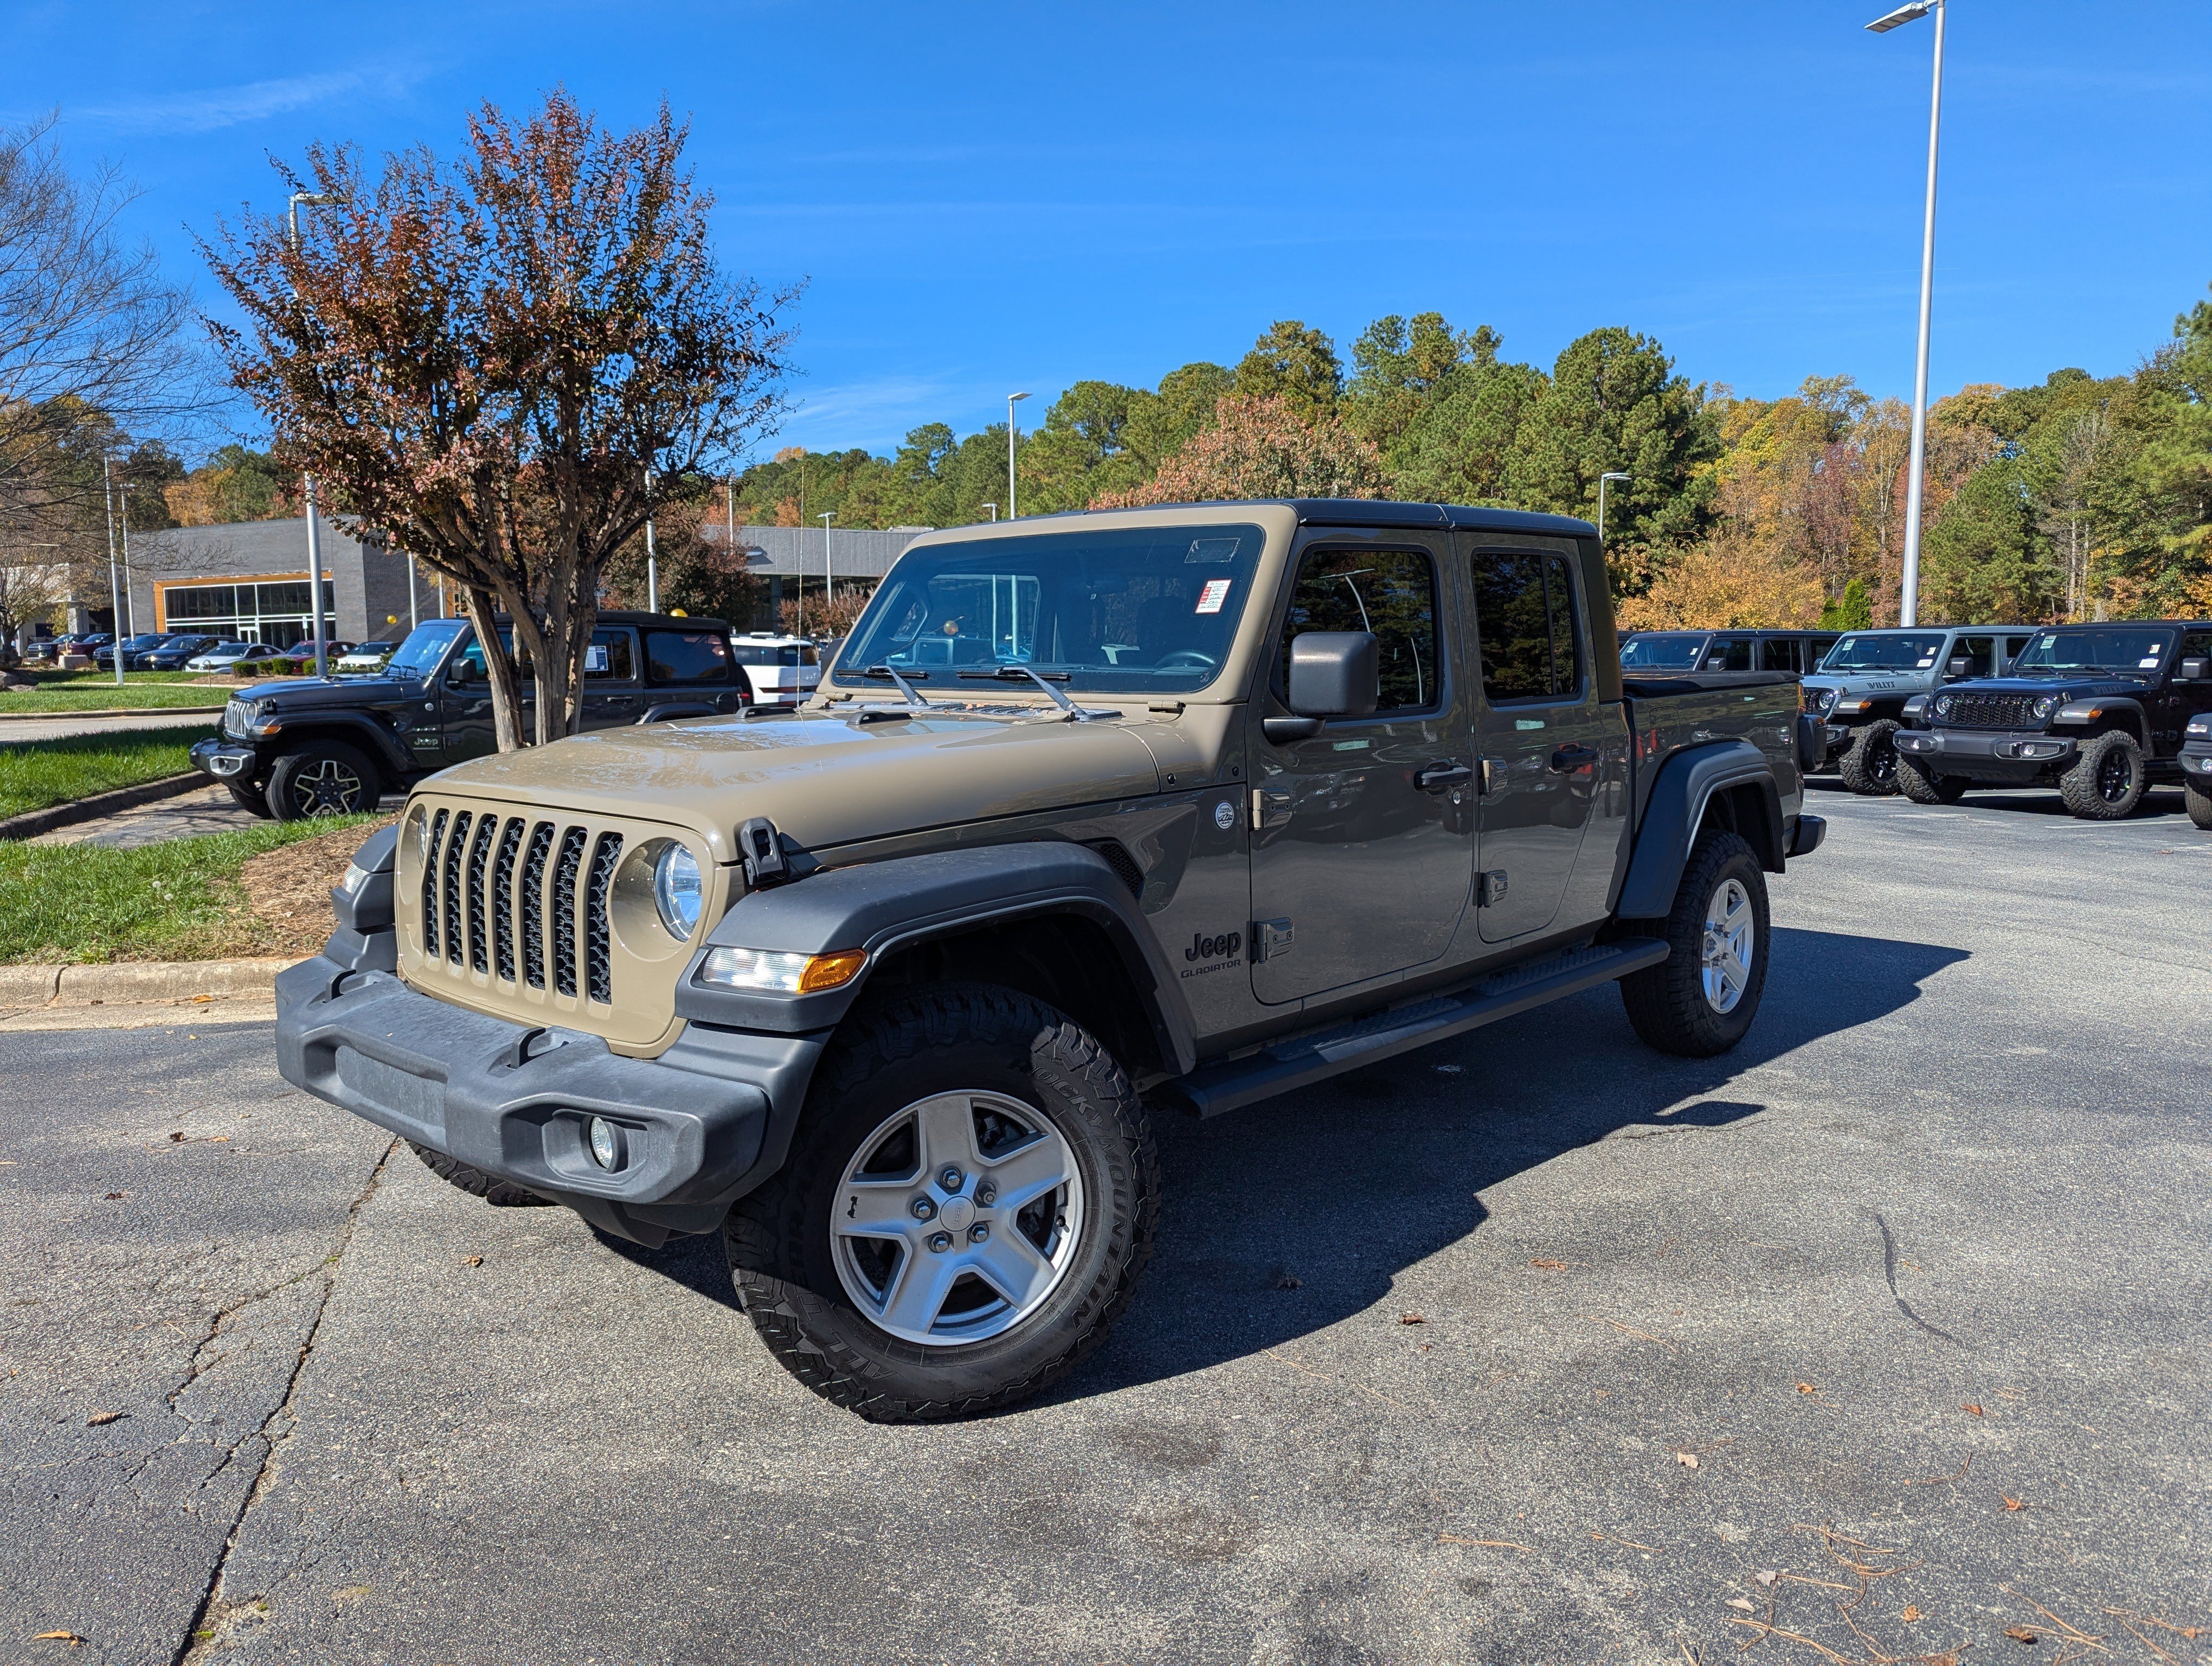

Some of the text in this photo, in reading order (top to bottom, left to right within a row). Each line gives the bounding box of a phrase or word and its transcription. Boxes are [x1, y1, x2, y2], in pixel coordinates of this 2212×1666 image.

[1866, 681, 1895, 689] WILLYS
[414, 737, 439, 746] Jeep
[1185, 932, 1242, 961] Jeep
[1181, 959, 1242, 978] GLADIATOR
[1006, 1058, 1129, 1330] ROCKY MOUNTAIN
[950, 1201, 964, 1228] Jeep
[827, 1329, 904, 1379] ALL
